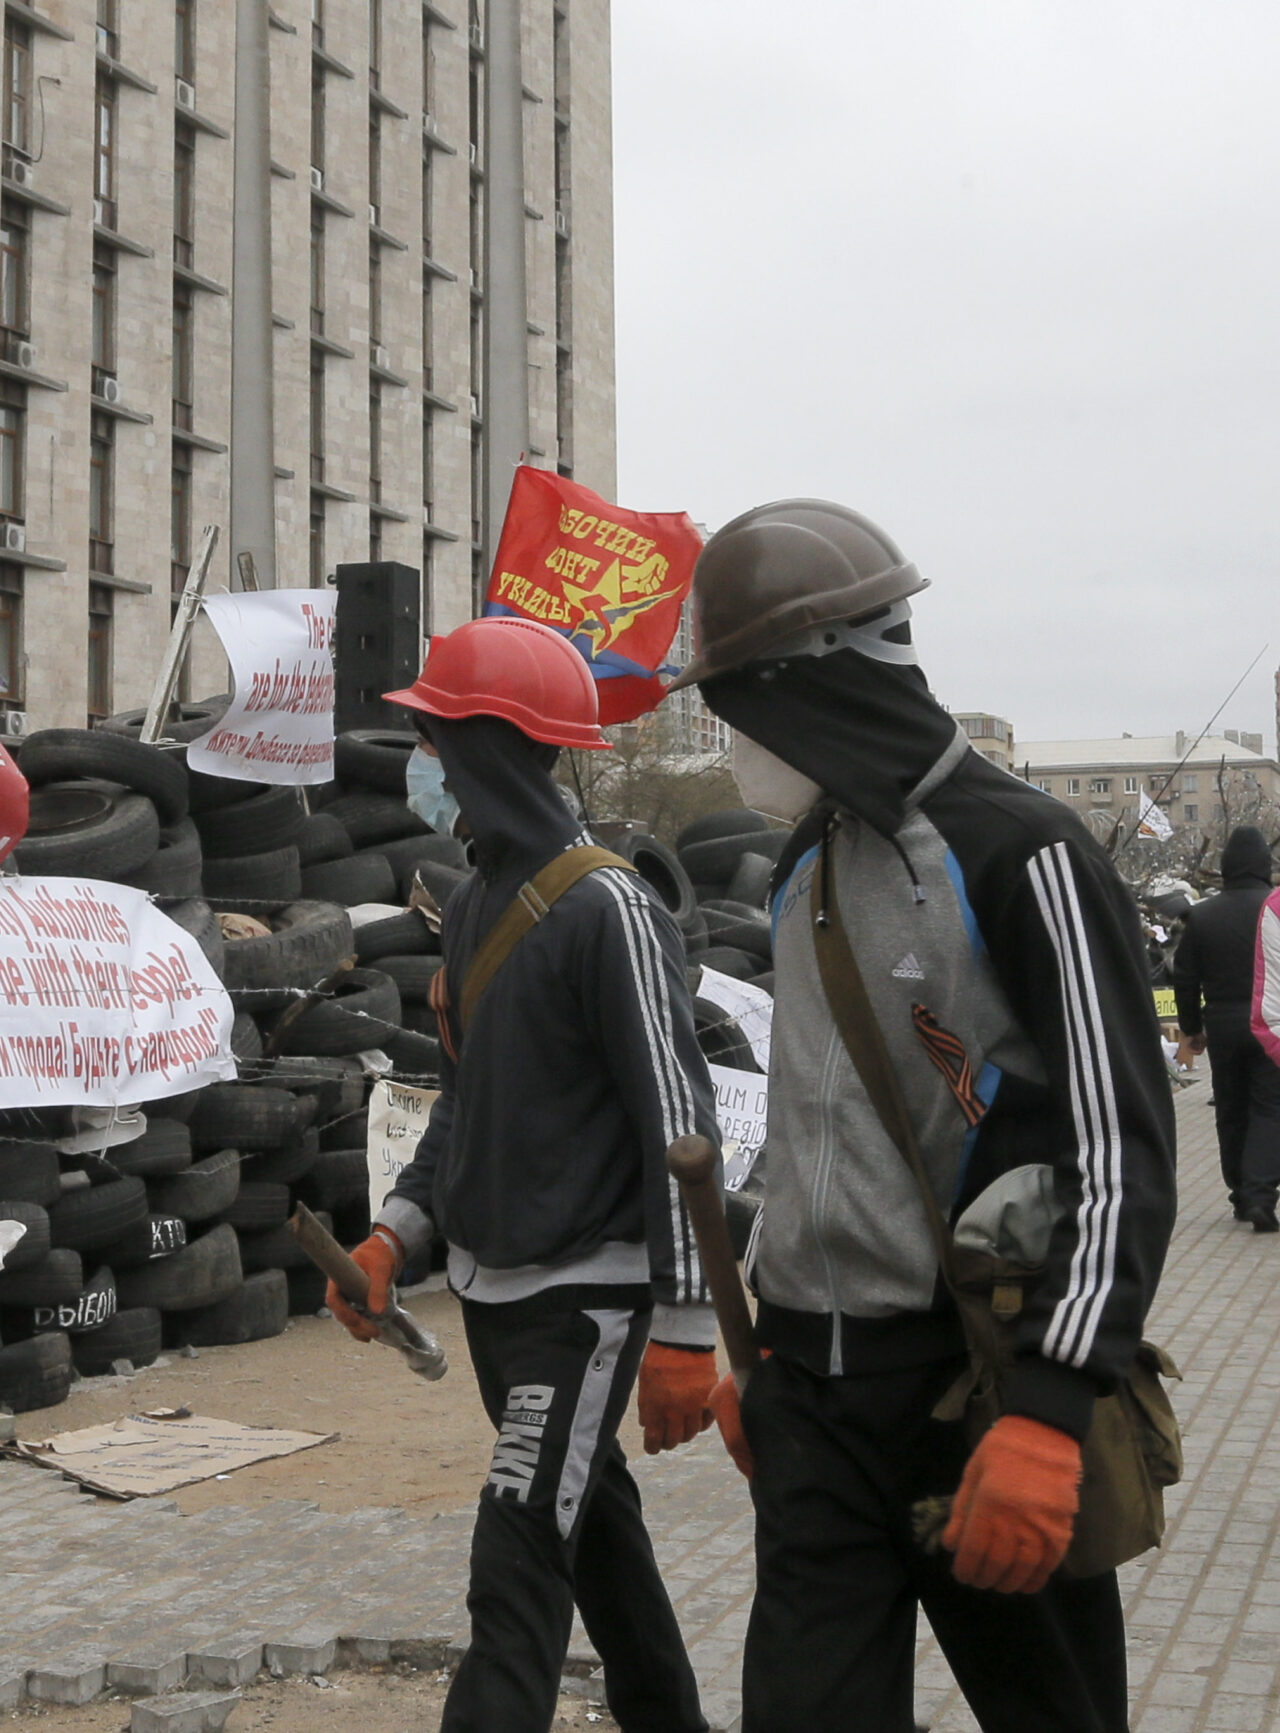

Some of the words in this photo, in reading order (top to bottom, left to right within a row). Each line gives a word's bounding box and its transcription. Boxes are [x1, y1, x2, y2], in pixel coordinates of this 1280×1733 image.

[301, 604, 325, 649] The
[22, 941, 81, 1008] with
[70, 944, 126, 1010] their
[8, 1021, 69, 1092] города!
[68, 1021, 120, 1093] Будьте
